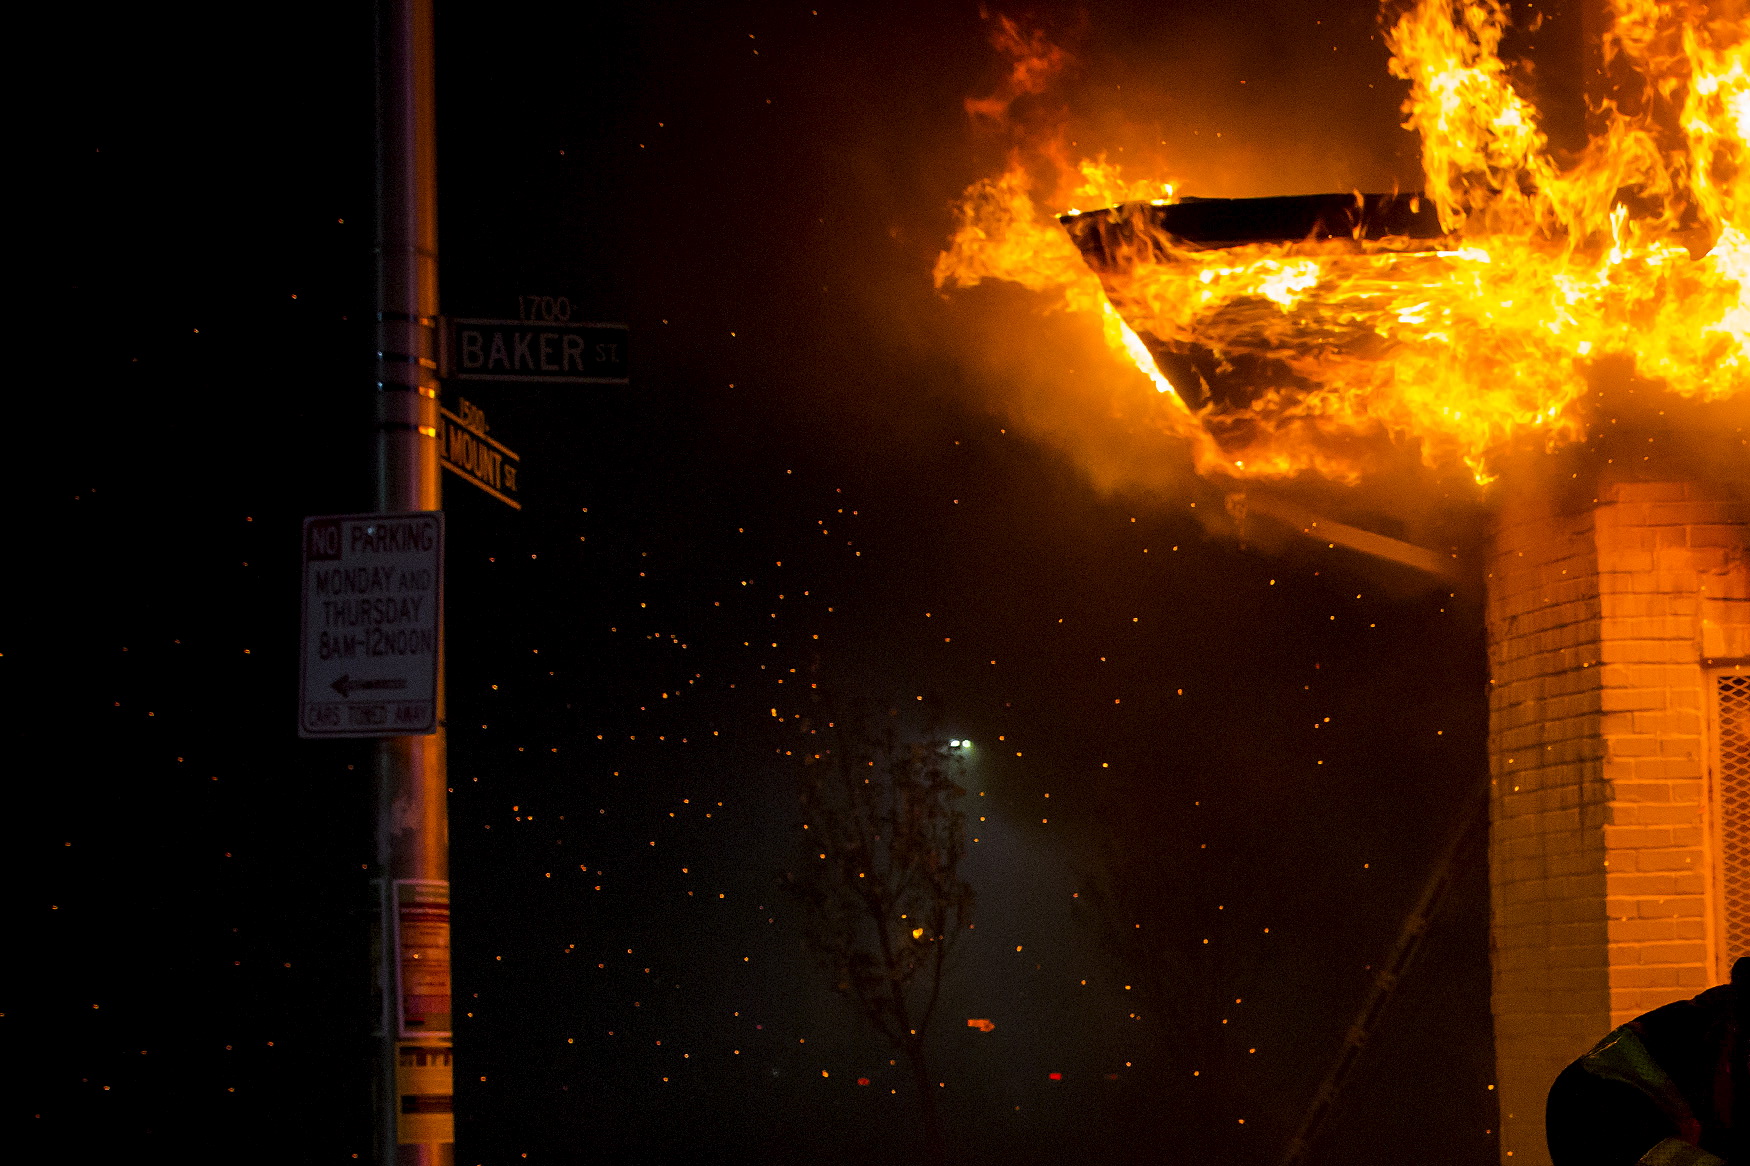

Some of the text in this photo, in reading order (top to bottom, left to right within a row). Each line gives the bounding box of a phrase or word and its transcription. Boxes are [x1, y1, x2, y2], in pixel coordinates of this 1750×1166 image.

[518, 296, 571, 322] 1700
[461, 329, 585, 372] BAKER
[449, 424, 503, 490] MOUNT
[312, 522, 434, 556] NO PARKING
[315, 566, 432, 597] MONDAY AND
[322, 596, 424, 627] THURSDAY
